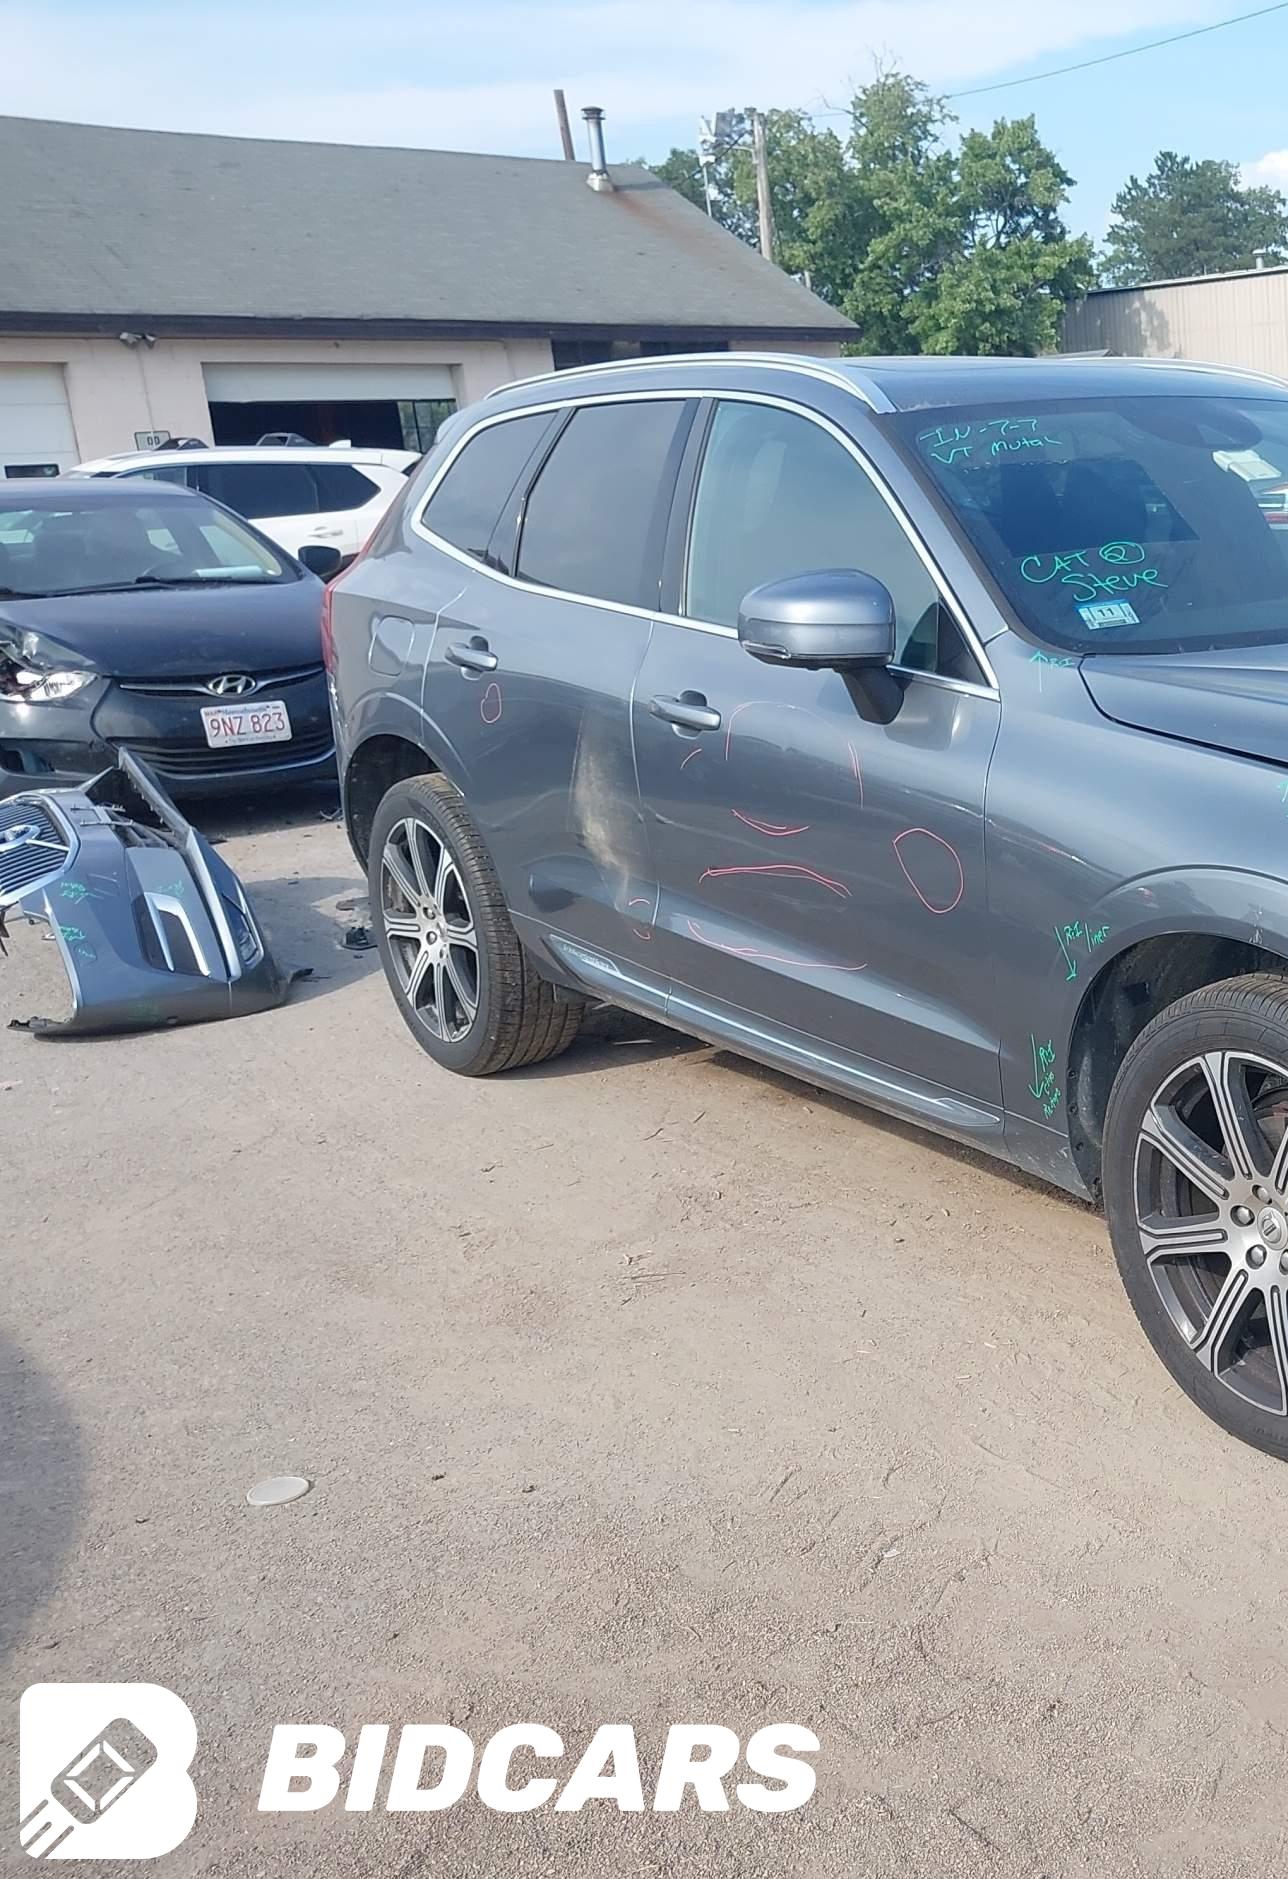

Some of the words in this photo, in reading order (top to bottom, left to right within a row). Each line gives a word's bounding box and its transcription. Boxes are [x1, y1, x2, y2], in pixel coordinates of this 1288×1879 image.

[1021, 551, 1090, 583] CAT
[1061, 569, 1168, 602] Steve
[209, 715, 247, 738] 9NZ
[249, 712, 286, 734] 823
